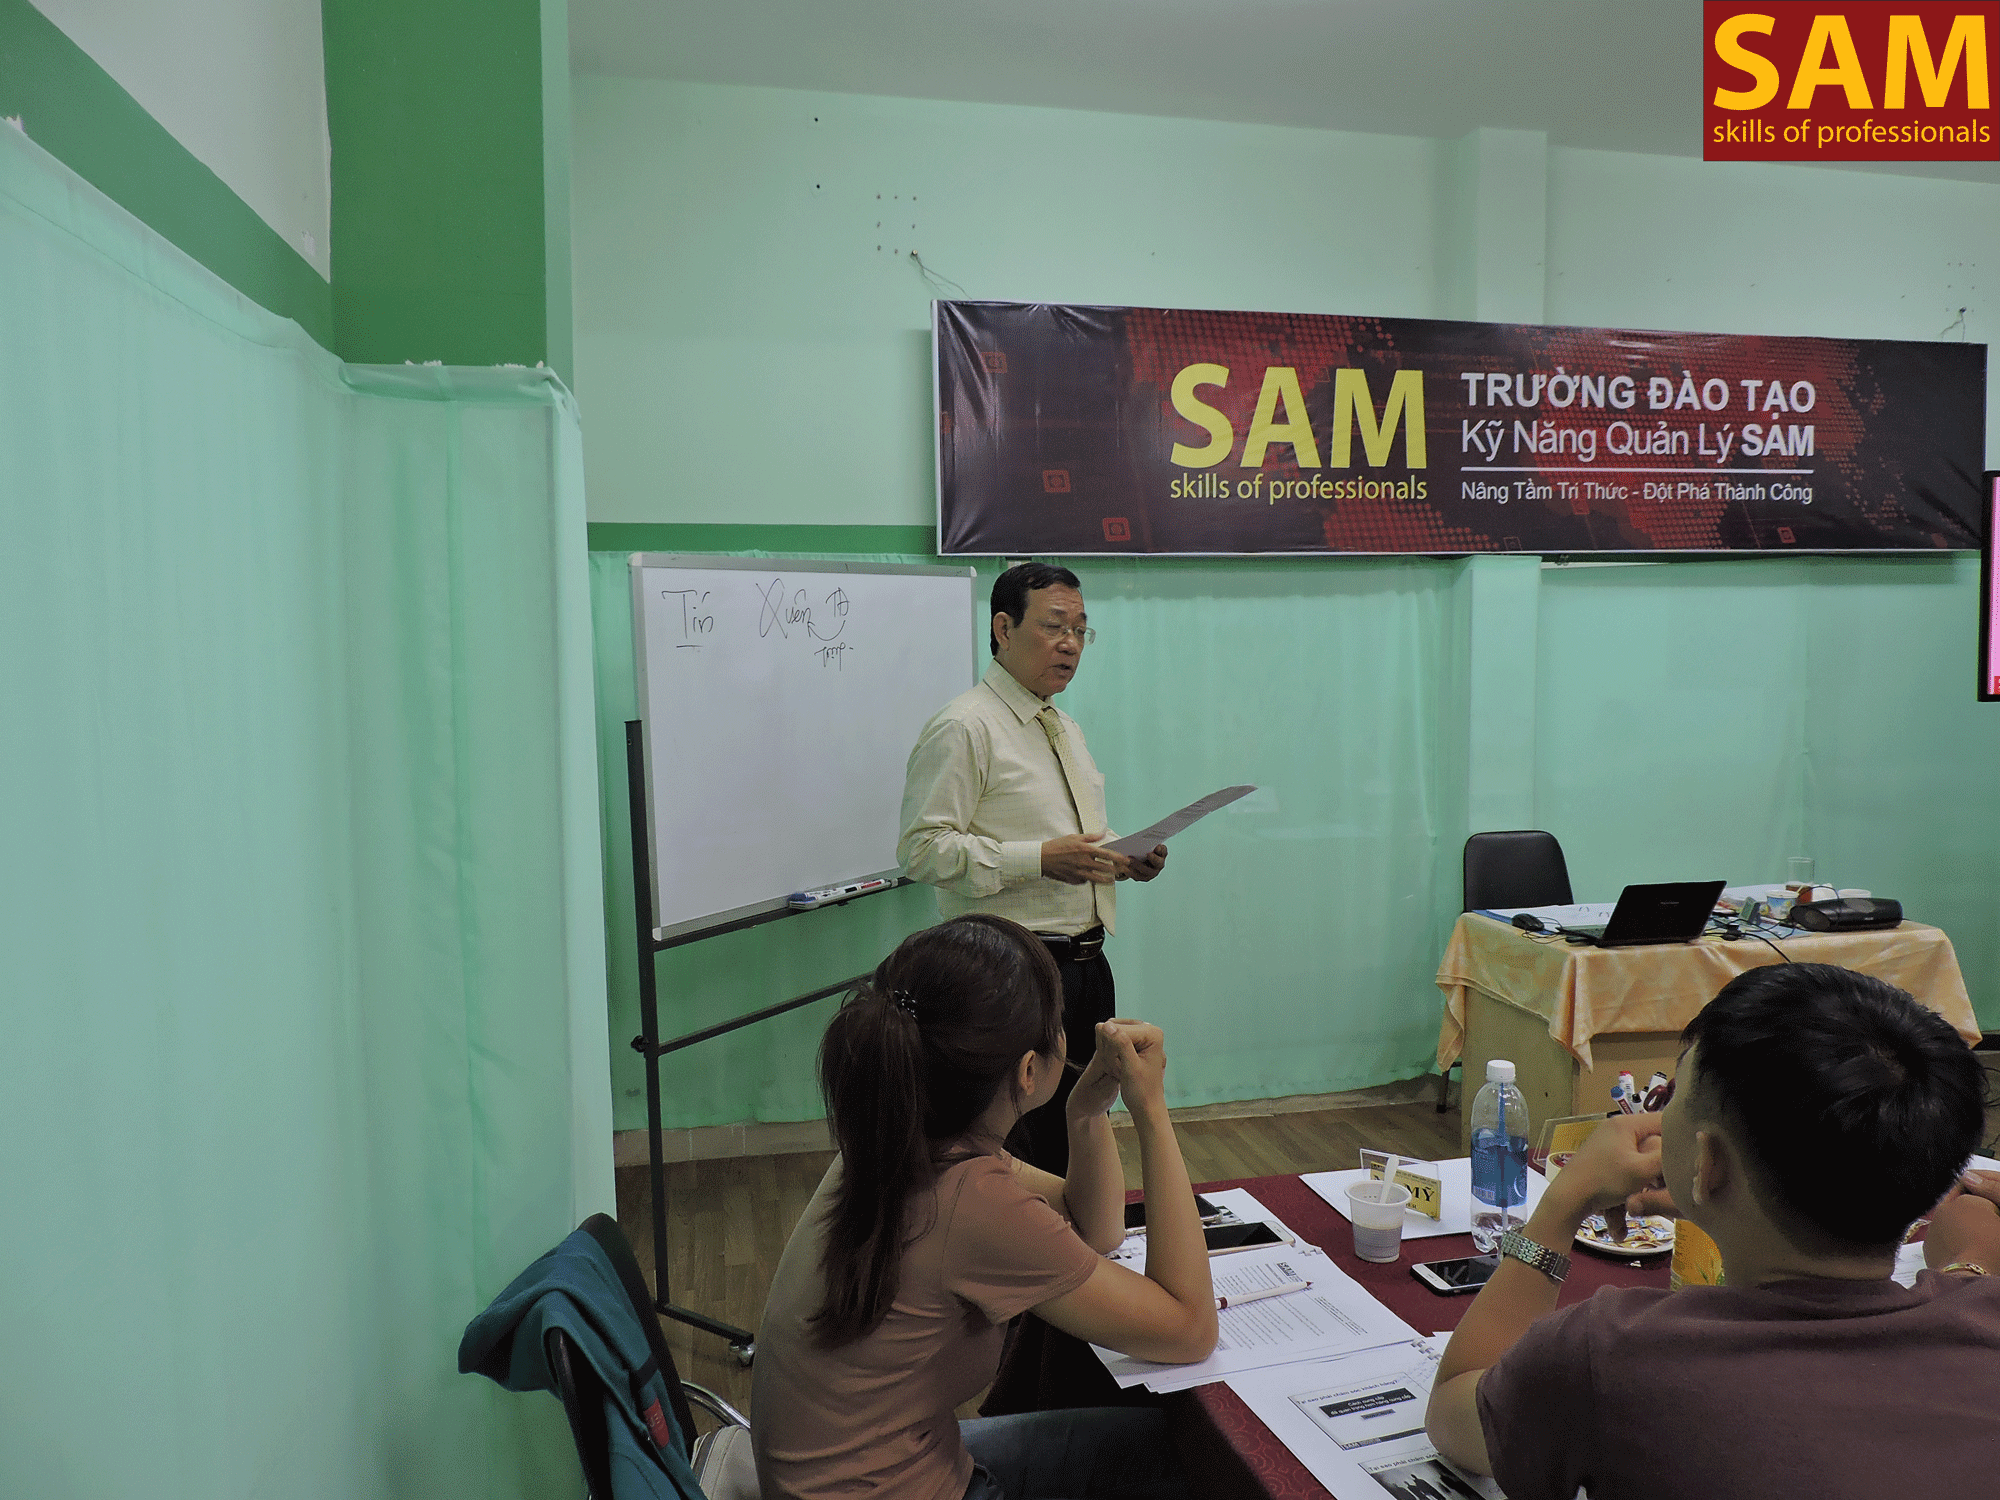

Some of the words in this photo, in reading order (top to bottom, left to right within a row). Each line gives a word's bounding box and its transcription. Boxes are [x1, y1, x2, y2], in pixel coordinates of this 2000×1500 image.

[1461, 367, 1636, 409] TRƯỜNG
[1647, 370, 1730, 411] ĐÀO
[1741, 379, 1816, 420] TẠO
[1170, 362, 1427, 469] SAM
[1462, 420, 1504, 462] Kỹ
[1514, 420, 1596, 462] Năng
[1606, 420, 1689, 456] Quản
[1699, 423, 1734, 463] Lý
[1741, 424, 1815, 457] SAM
[1170, 473, 1230, 499] skills
[1237, 473, 1264, 499] of
[1269, 475, 1428, 505] professionals
[1461, 481, 1509, 504] Nâng
[1513, 478, 1552, 500] Tầm
[1583, 481, 1629, 501] Thức
[1643, 481, 1673, 502] Đột
[1677, 482, 1710, 500] Phá
[1714, 482, 1766, 501] Thành
[1770, 482, 1813, 505] Công
